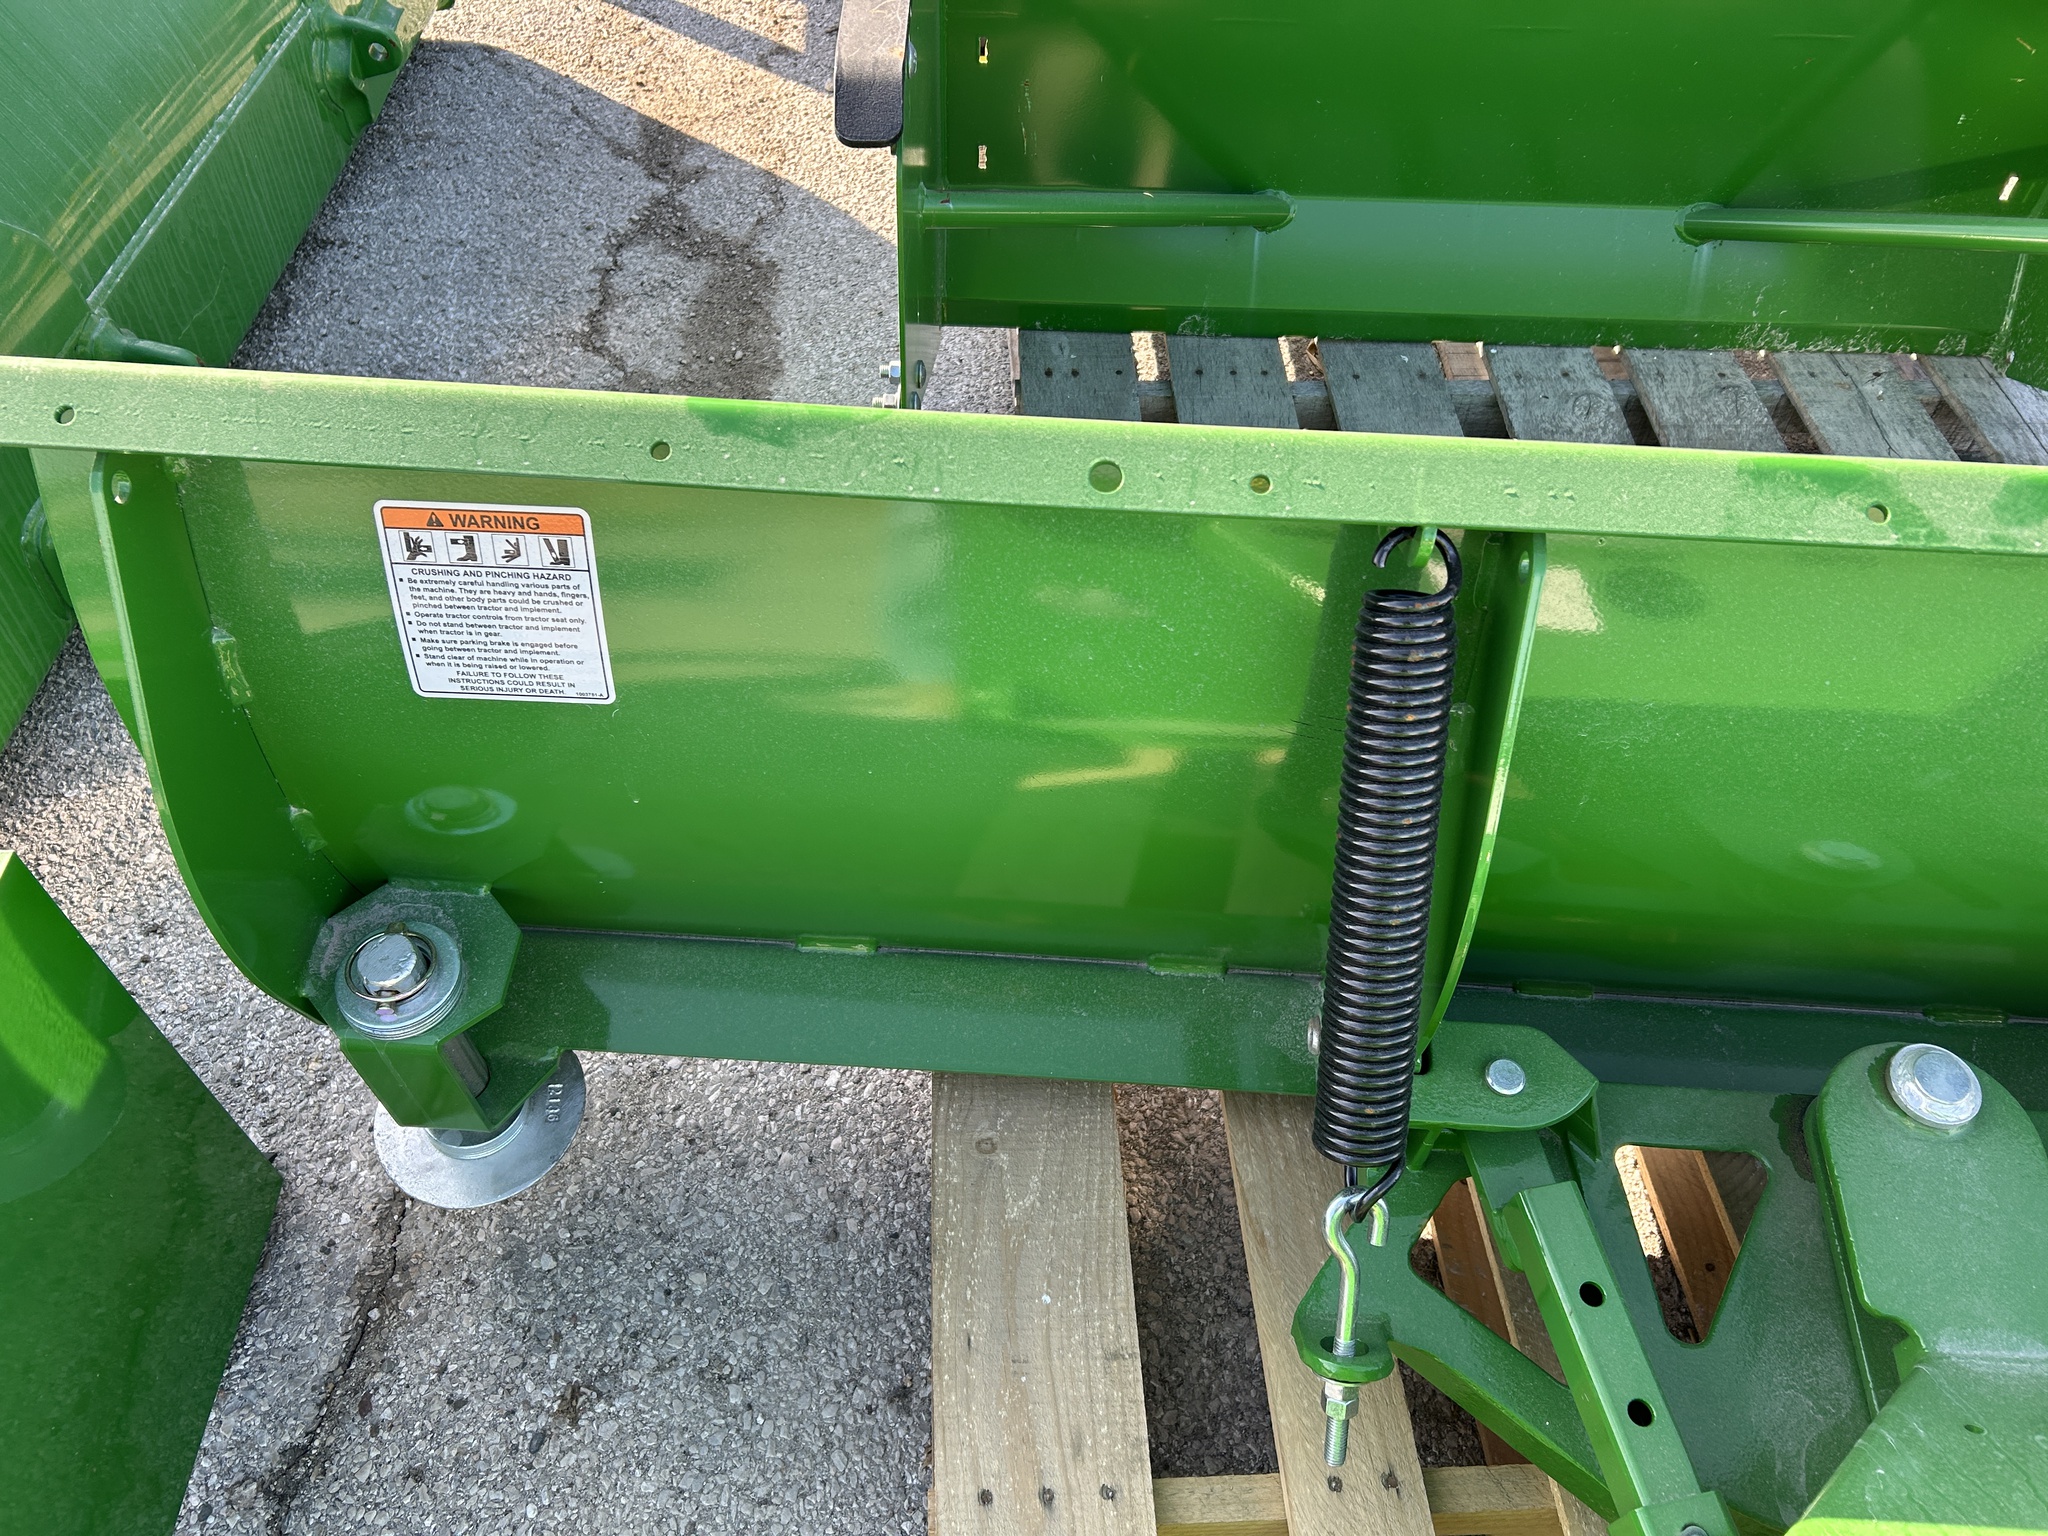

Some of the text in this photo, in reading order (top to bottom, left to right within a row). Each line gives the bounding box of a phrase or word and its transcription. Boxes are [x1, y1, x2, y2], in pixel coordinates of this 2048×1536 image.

[448, 513, 540, 531] WARNING
[411, 567, 572, 581] CRUSHING AND PINCHING HAZARD
[419, 578, 456, 586] extremely
[485, 580, 520, 589] handling
[410, 593, 427, 601] feet,
[465, 595, 485, 604] body
[458, 587, 477, 596] They
[492, 588, 516, 597] heavy
[533, 590, 560, 598] hands,
[560, 591, 590, 600] fingers,
[447, 677, 505, 685] INSTRUCTIONS
